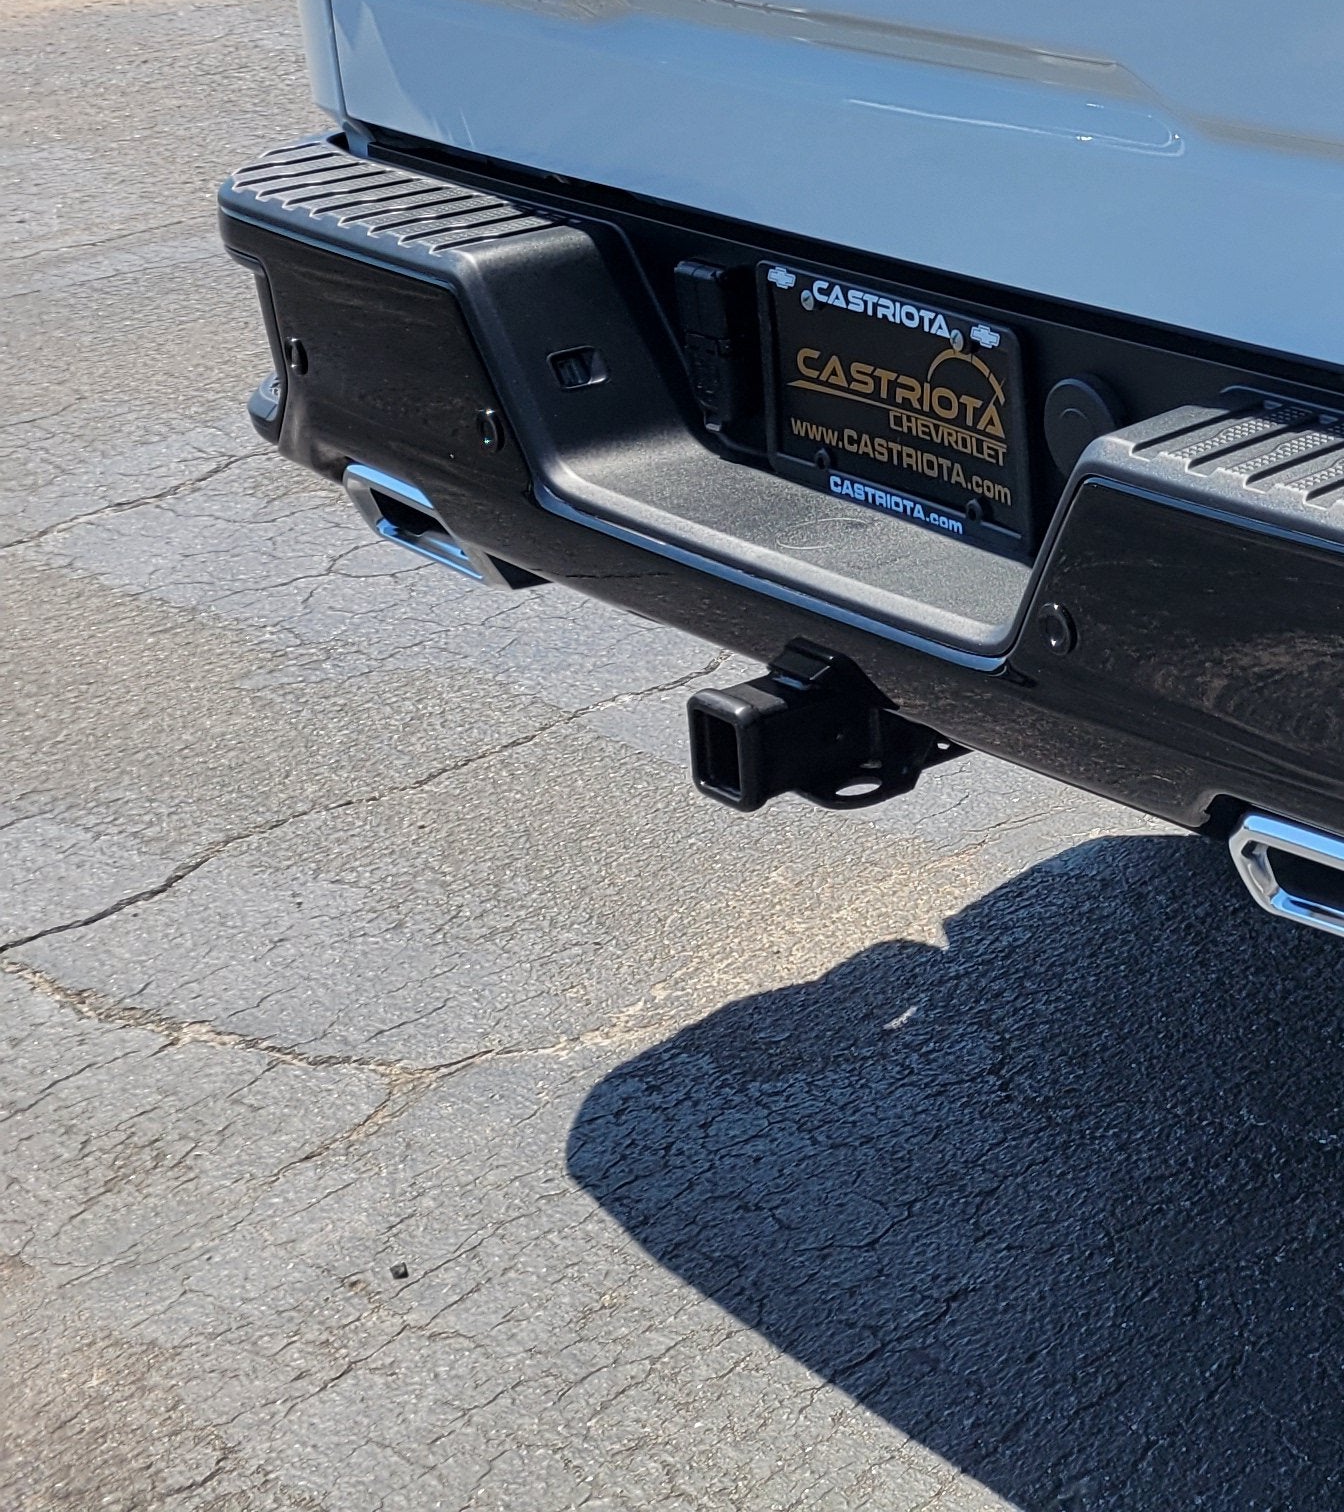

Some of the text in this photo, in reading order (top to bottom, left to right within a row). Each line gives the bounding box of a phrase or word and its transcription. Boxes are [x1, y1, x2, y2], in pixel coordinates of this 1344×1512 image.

[812, 280, 951, 339] CASTRIOTA
[796, 347, 1006, 439] CASTRIOTA
[791, 417, 1012, 506] www.CASTRIOTA.com
[889, 410, 1007, 467] CHEVROLET
[829, 475, 963, 535] CASTRIOTA.com
